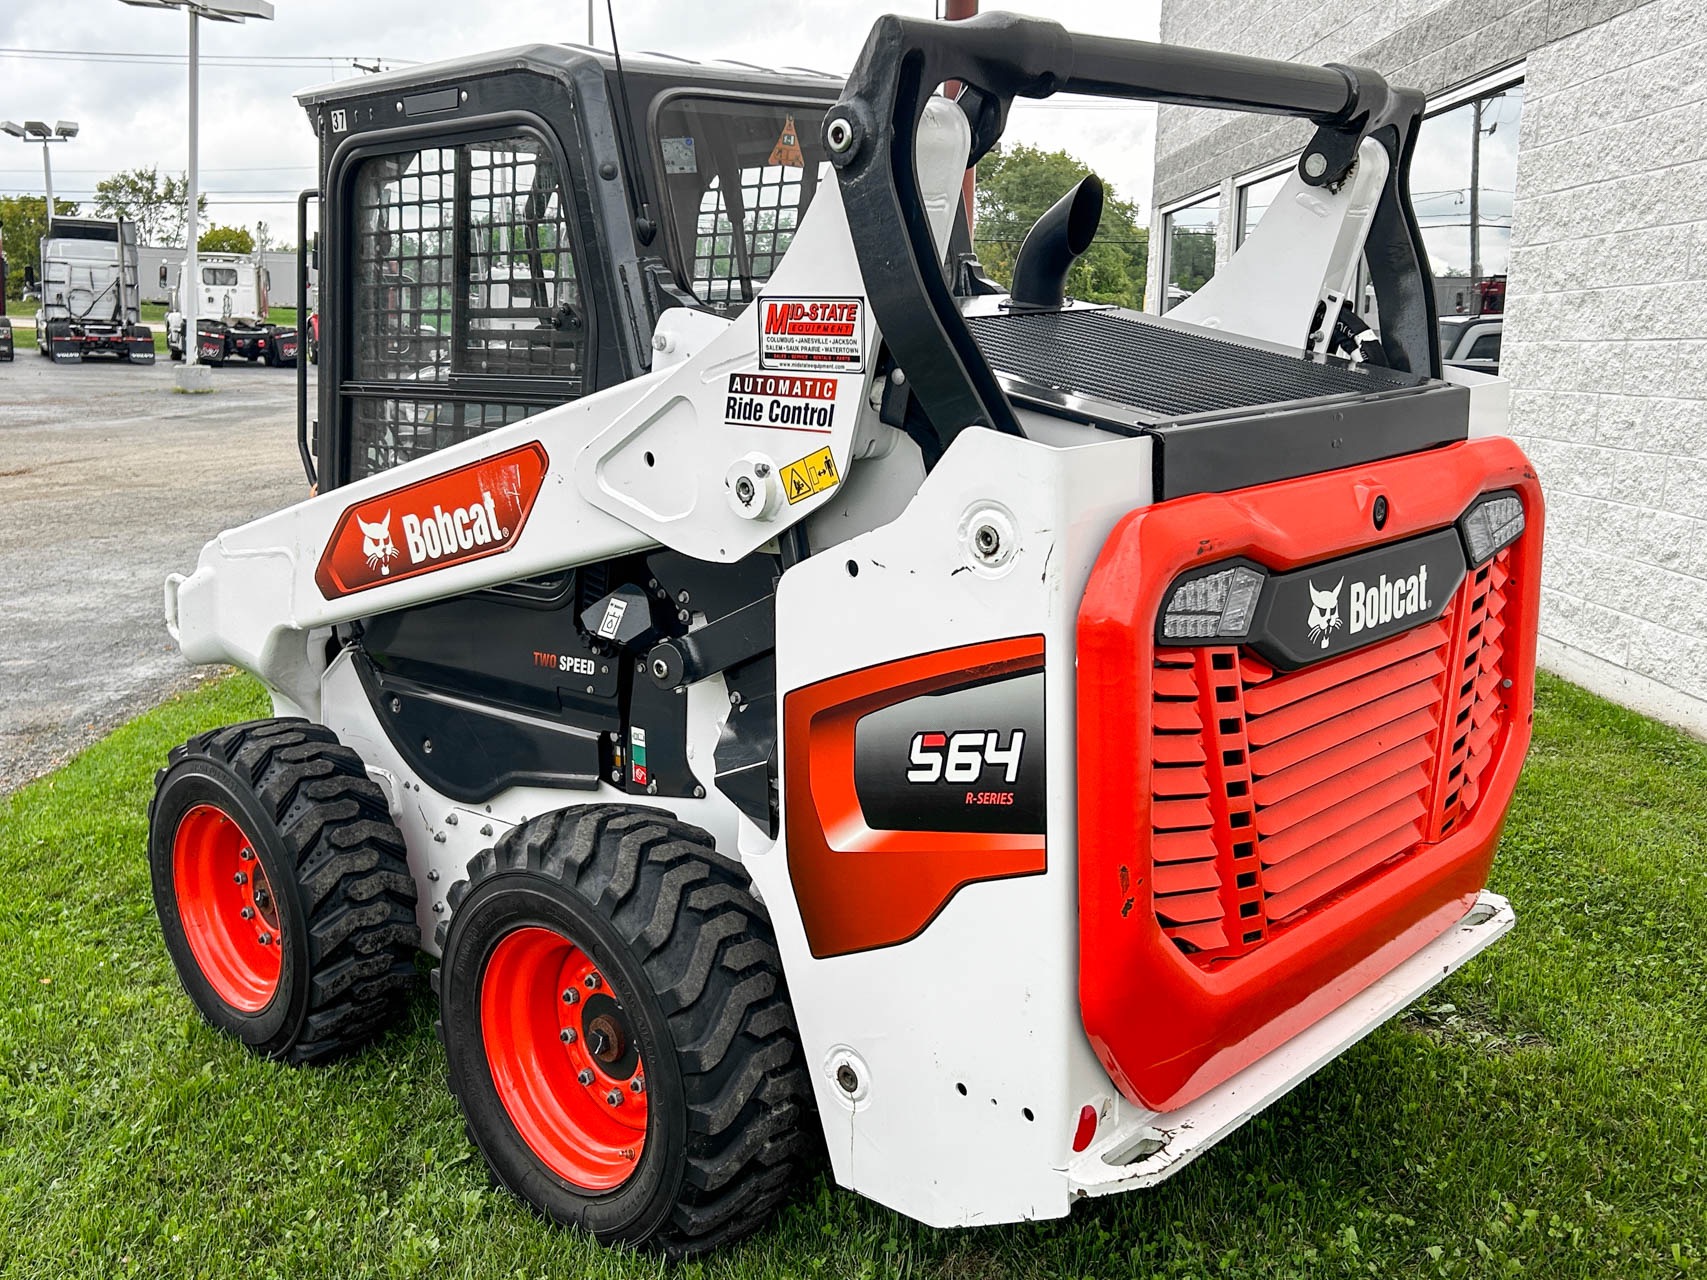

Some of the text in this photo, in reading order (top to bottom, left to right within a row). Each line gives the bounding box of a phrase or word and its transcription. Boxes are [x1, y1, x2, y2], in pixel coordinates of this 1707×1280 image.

[333, 112, 344, 130] 37
[765, 303, 858, 334] MID-STATE
[791, 324, 850, 333] EQUIPMENT
[766, 336, 858, 346] COLUMBUS JANESVILLE JACKSON
[824, 346, 859, 354] WATERTOWN
[779, 362, 845, 370] www.midstateequipment.com
[732, 376, 833, 398] AUTOMATIC
[725, 396, 835, 427] Ride Control
[402, 491, 503, 565] Bobcat
[1350, 564, 1428, 635] Bobcat
[533, 651, 595, 676] TWO SPEED
[906, 730, 1025, 784] S64
[965, 792, 1014, 805] R-SERIES
